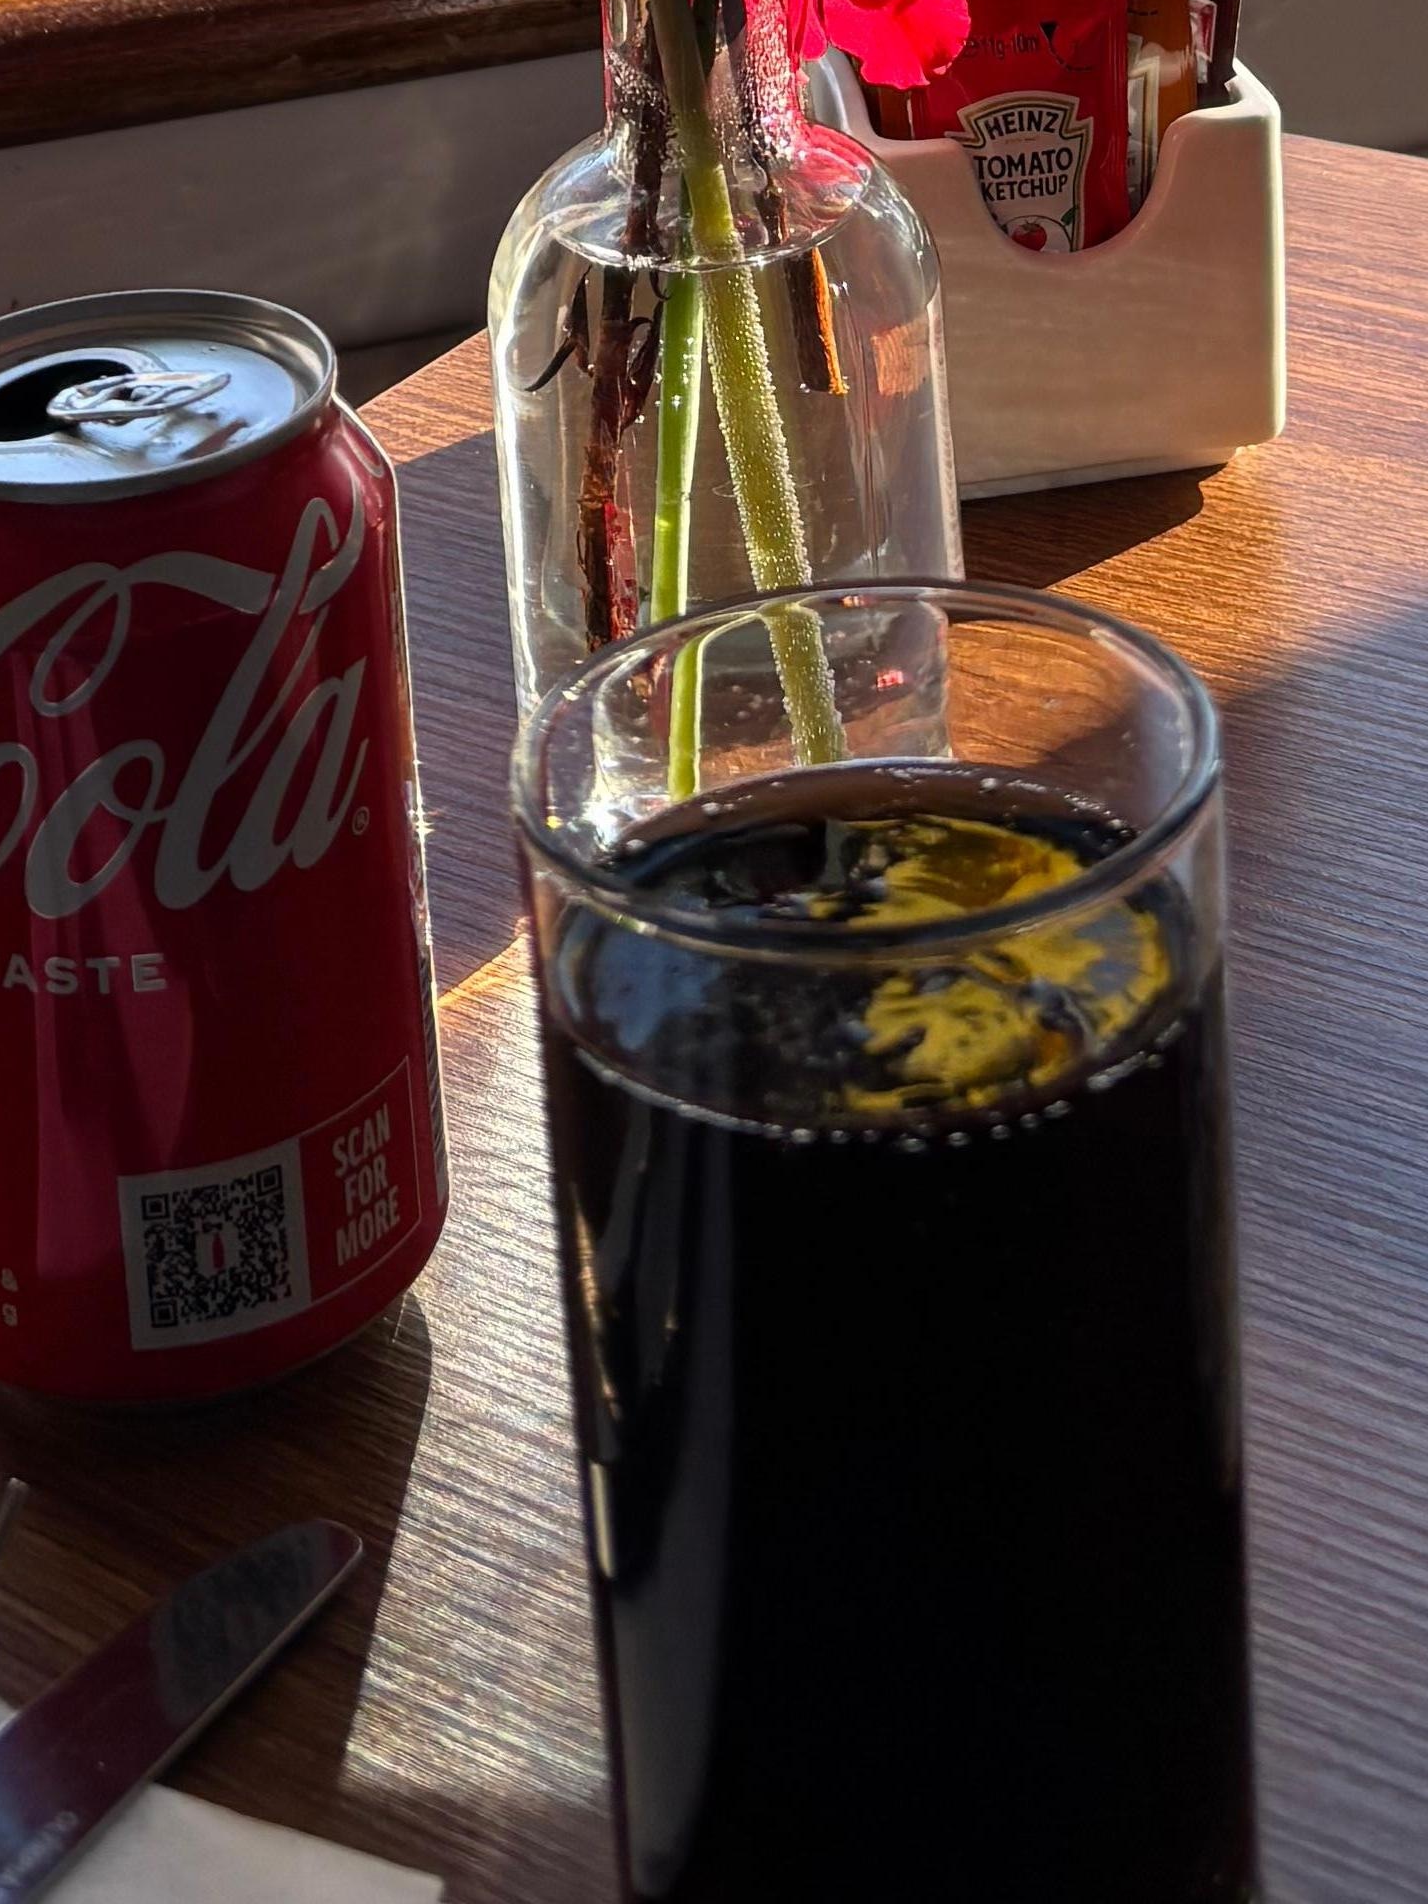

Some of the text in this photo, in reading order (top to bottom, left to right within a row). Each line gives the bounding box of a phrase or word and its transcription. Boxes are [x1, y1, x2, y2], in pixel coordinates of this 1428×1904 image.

[983, 110, 1060, 141] HEINZ
[973, 147, 1073, 180] TOMATO
[980, 174, 1068, 202] KETCHUP
[332, 1102, 391, 1178] SCAN
[344, 1154, 388, 1216] FOR
[336, 1185, 400, 1266] MORE
